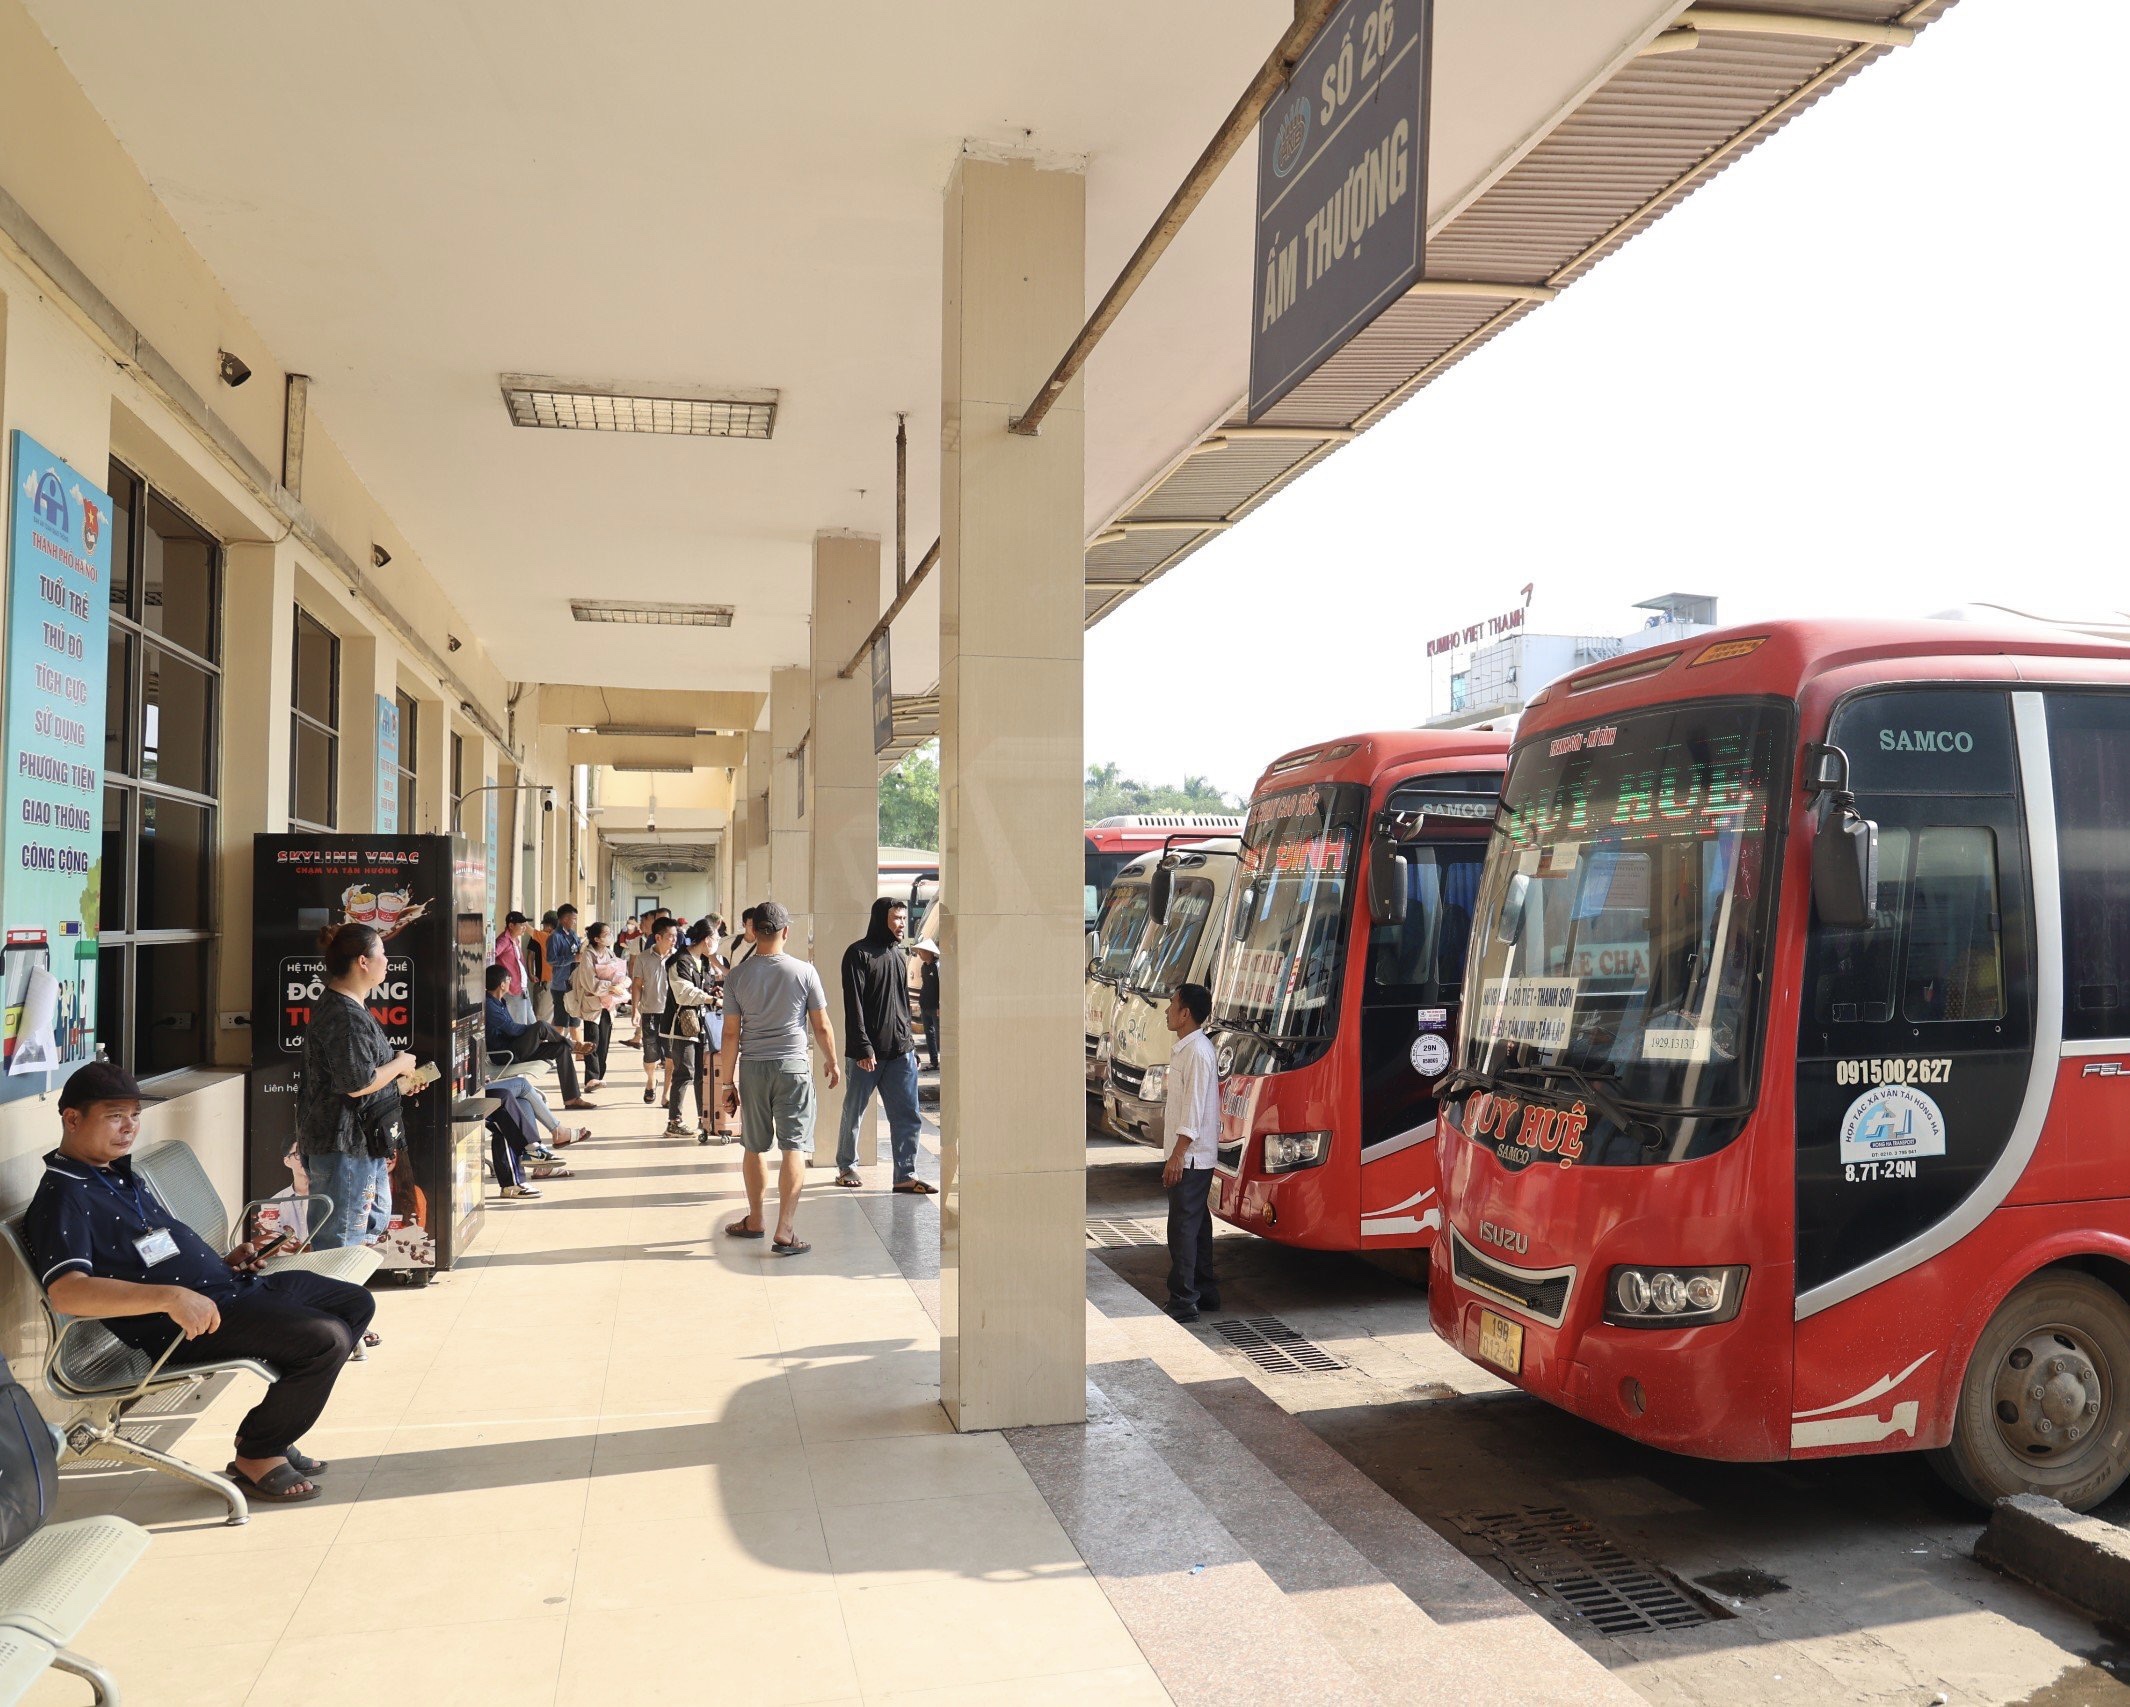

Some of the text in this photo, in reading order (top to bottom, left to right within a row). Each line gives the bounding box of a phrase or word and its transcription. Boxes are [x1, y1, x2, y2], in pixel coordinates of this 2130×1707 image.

[1320, 0, 1394, 126] SỐ 26
[1261, 117, 1410, 334] ẤM THƯỢNG
[39, 573, 90, 621] TUỔI TRẺ
[42, 621, 84, 661] THỦ ĐÔ
[1426, 607, 1525, 658] KUMHO VIET THANH
[35, 660, 88, 707] TÍCH CỰC
[34, 705, 86, 748] SỬ DỤNG
[1879, 729, 1974, 753] SAMCO
[19, 750, 96, 796] PHƯƠNG TIỆN
[22, 797, 91, 833] GIAO THÔNG
[1422, 803, 1487, 817] SAMCO
[21, 840, 89, 878] CÔNG CỘNG
[277, 850, 420, 865] SKYLINE VMAC
[287, 962, 302, 974] HỆ
[303, 961, 327, 972] THỐ
[1599, 948, 1649, 976] CHA
[286, 974, 408, 1001] ĐỒ NG
[1537, 986, 1559, 1007] THANH
[1559, 985, 1575, 1008] SƠN
[285, 1036, 408, 1047] LỚ AM
[1423, 1044, 1437, 1052] 29N
[264, 1083, 299, 1094] Liên hệ
[1845, 1122, 1856, 1143] HỢP
[1854, 1103, 1868, 1121] TÁC
[1867, 1092, 1880, 1106] XÃ
[1881, 1088, 1898, 1100] VẬN
[1900, 1089, 1914, 1102] TẢI
[1516, 1099, 1588, 1170] HUỆ
[1497, 1143, 1530, 1165] SAMCO
[1478, 1219, 1529, 1255] ISUZU
